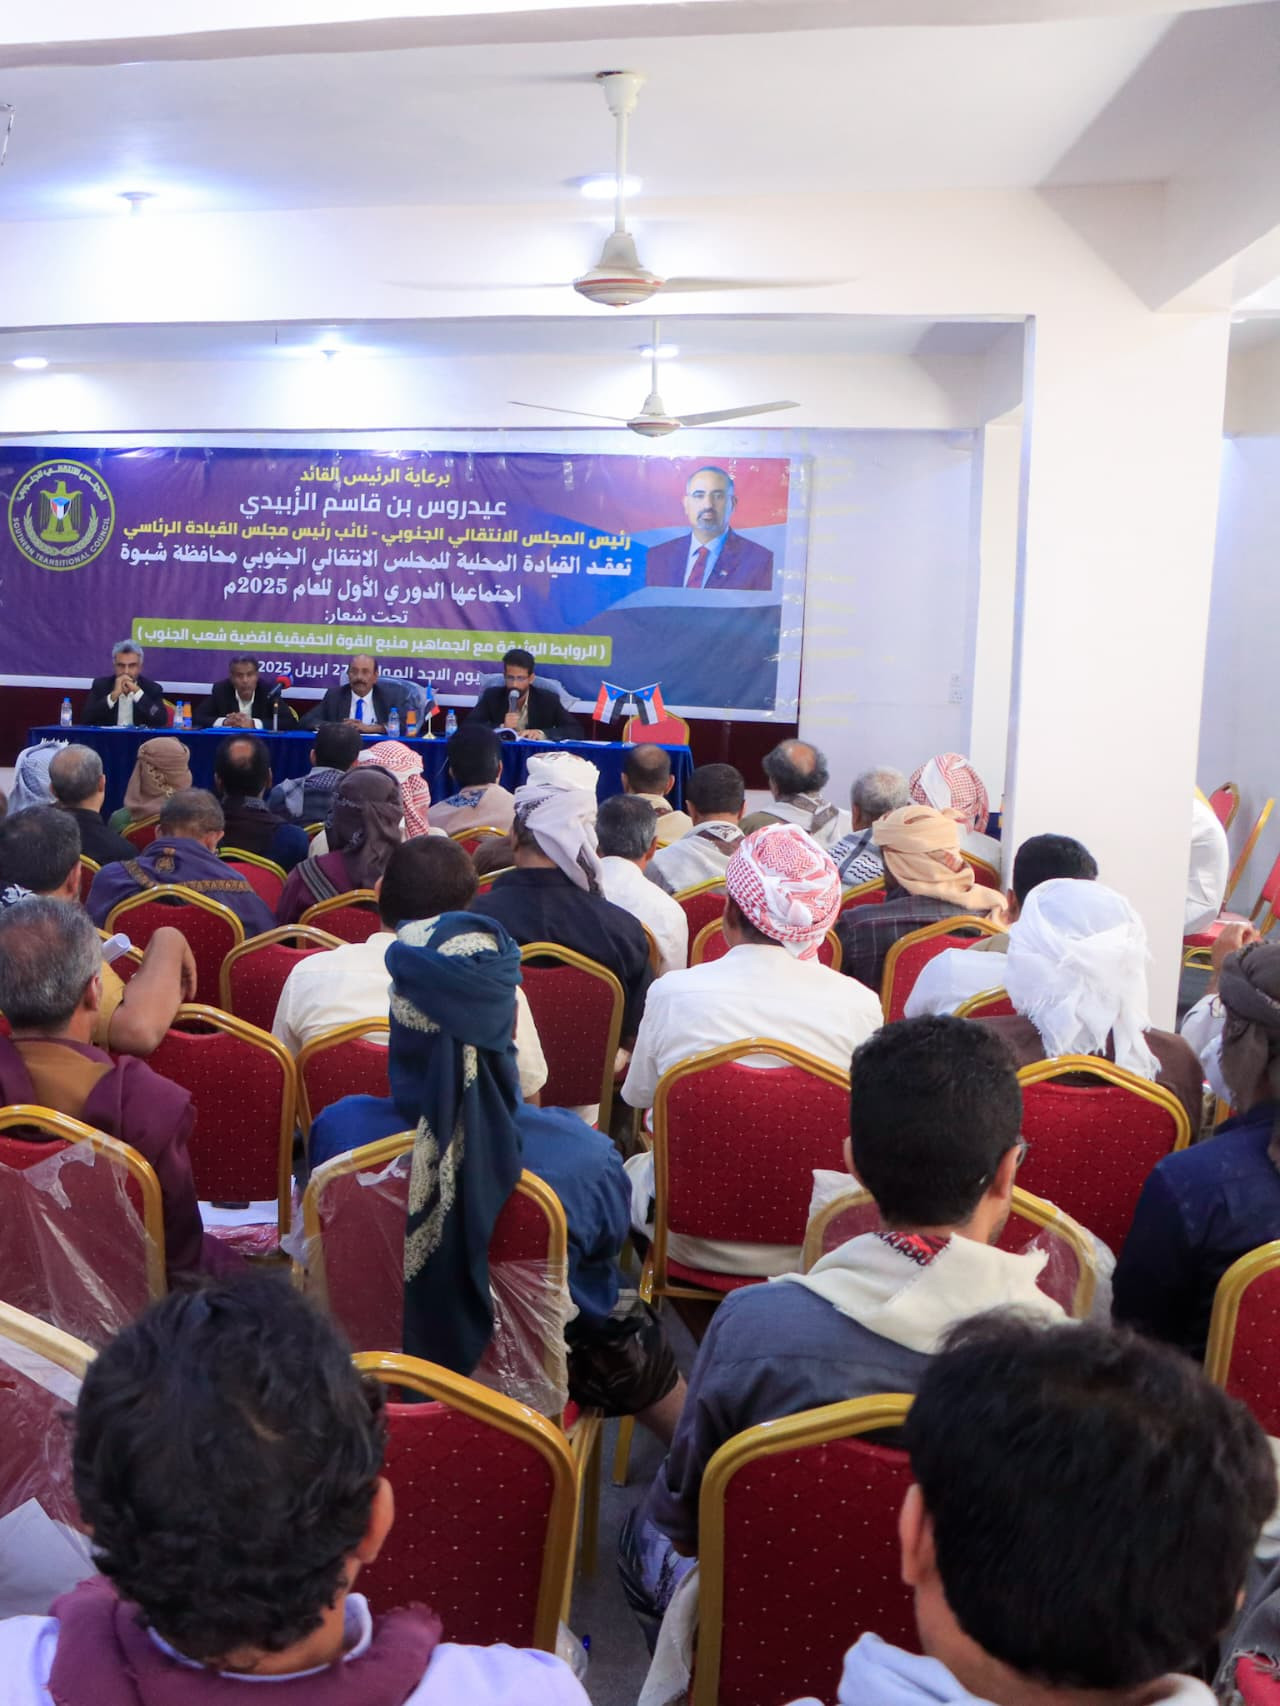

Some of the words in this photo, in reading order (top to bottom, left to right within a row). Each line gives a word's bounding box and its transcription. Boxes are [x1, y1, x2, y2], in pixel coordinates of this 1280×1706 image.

[300, 465, 339, 481] القائد
[344, 466, 400, 486] الرئيس
[405, 467, 450, 487] برعاية
[323, 494, 380, 518] قاسم
[387, 496, 411, 517] بن
[418, 500, 506, 519] عيدروس
[123, 518, 182, 537] الرئاسي
[185, 521, 238, 538] القيادة
[241, 523, 289, 539] مجلس
[291, 519, 331, 540] رئيس
[334, 521, 368, 542] نائب
[381, 526, 444, 546] الجنوبي
[12, 517, 34, 556] SOUTHERN
[35, 551, 90, 567] TRANSITIONAL
[90, 517, 110, 553] COUNCIL
[448, 528, 518, 549] الانتقالي
[521, 529, 585, 548] المجلس
[588, 530, 631, 550] رئيس
[120, 541, 168, 564] شبوة
[173, 544, 237, 563] محافظة
[243, 547, 306, 573] الجنوبي
[312, 547, 377, 575] الانتقالي
[384, 551, 450, 572] للمجلس
[457, 553, 516, 575] المحلية
[523, 555, 581, 578] القيادة
[293, 578, 332, 602] للعام
[338, 575, 377, 602] الأول
[384, 582, 444, 604] الدوري
[452, 583, 520, 607] اجتماعها
[372, 611, 408, 623] تحت
[145, 628, 189, 642] الجنوب
[192, 628, 227, 642] شعب
[230, 631, 272, 645] لقضية
[274, 632, 333, 647] الحقيقية
[336, 634, 373, 650] القوة
[376, 637, 408, 652] منبع
[411, 638, 470, 654] الجماهير
[473, 642, 494, 656] مع
[550, 644, 597, 660] الروابط
[259, 661, 291, 675] 2025
[295, 662, 328, 678] ابريل
[417, 668, 451, 681] الاحد
[454, 671, 481, 686] يوم
